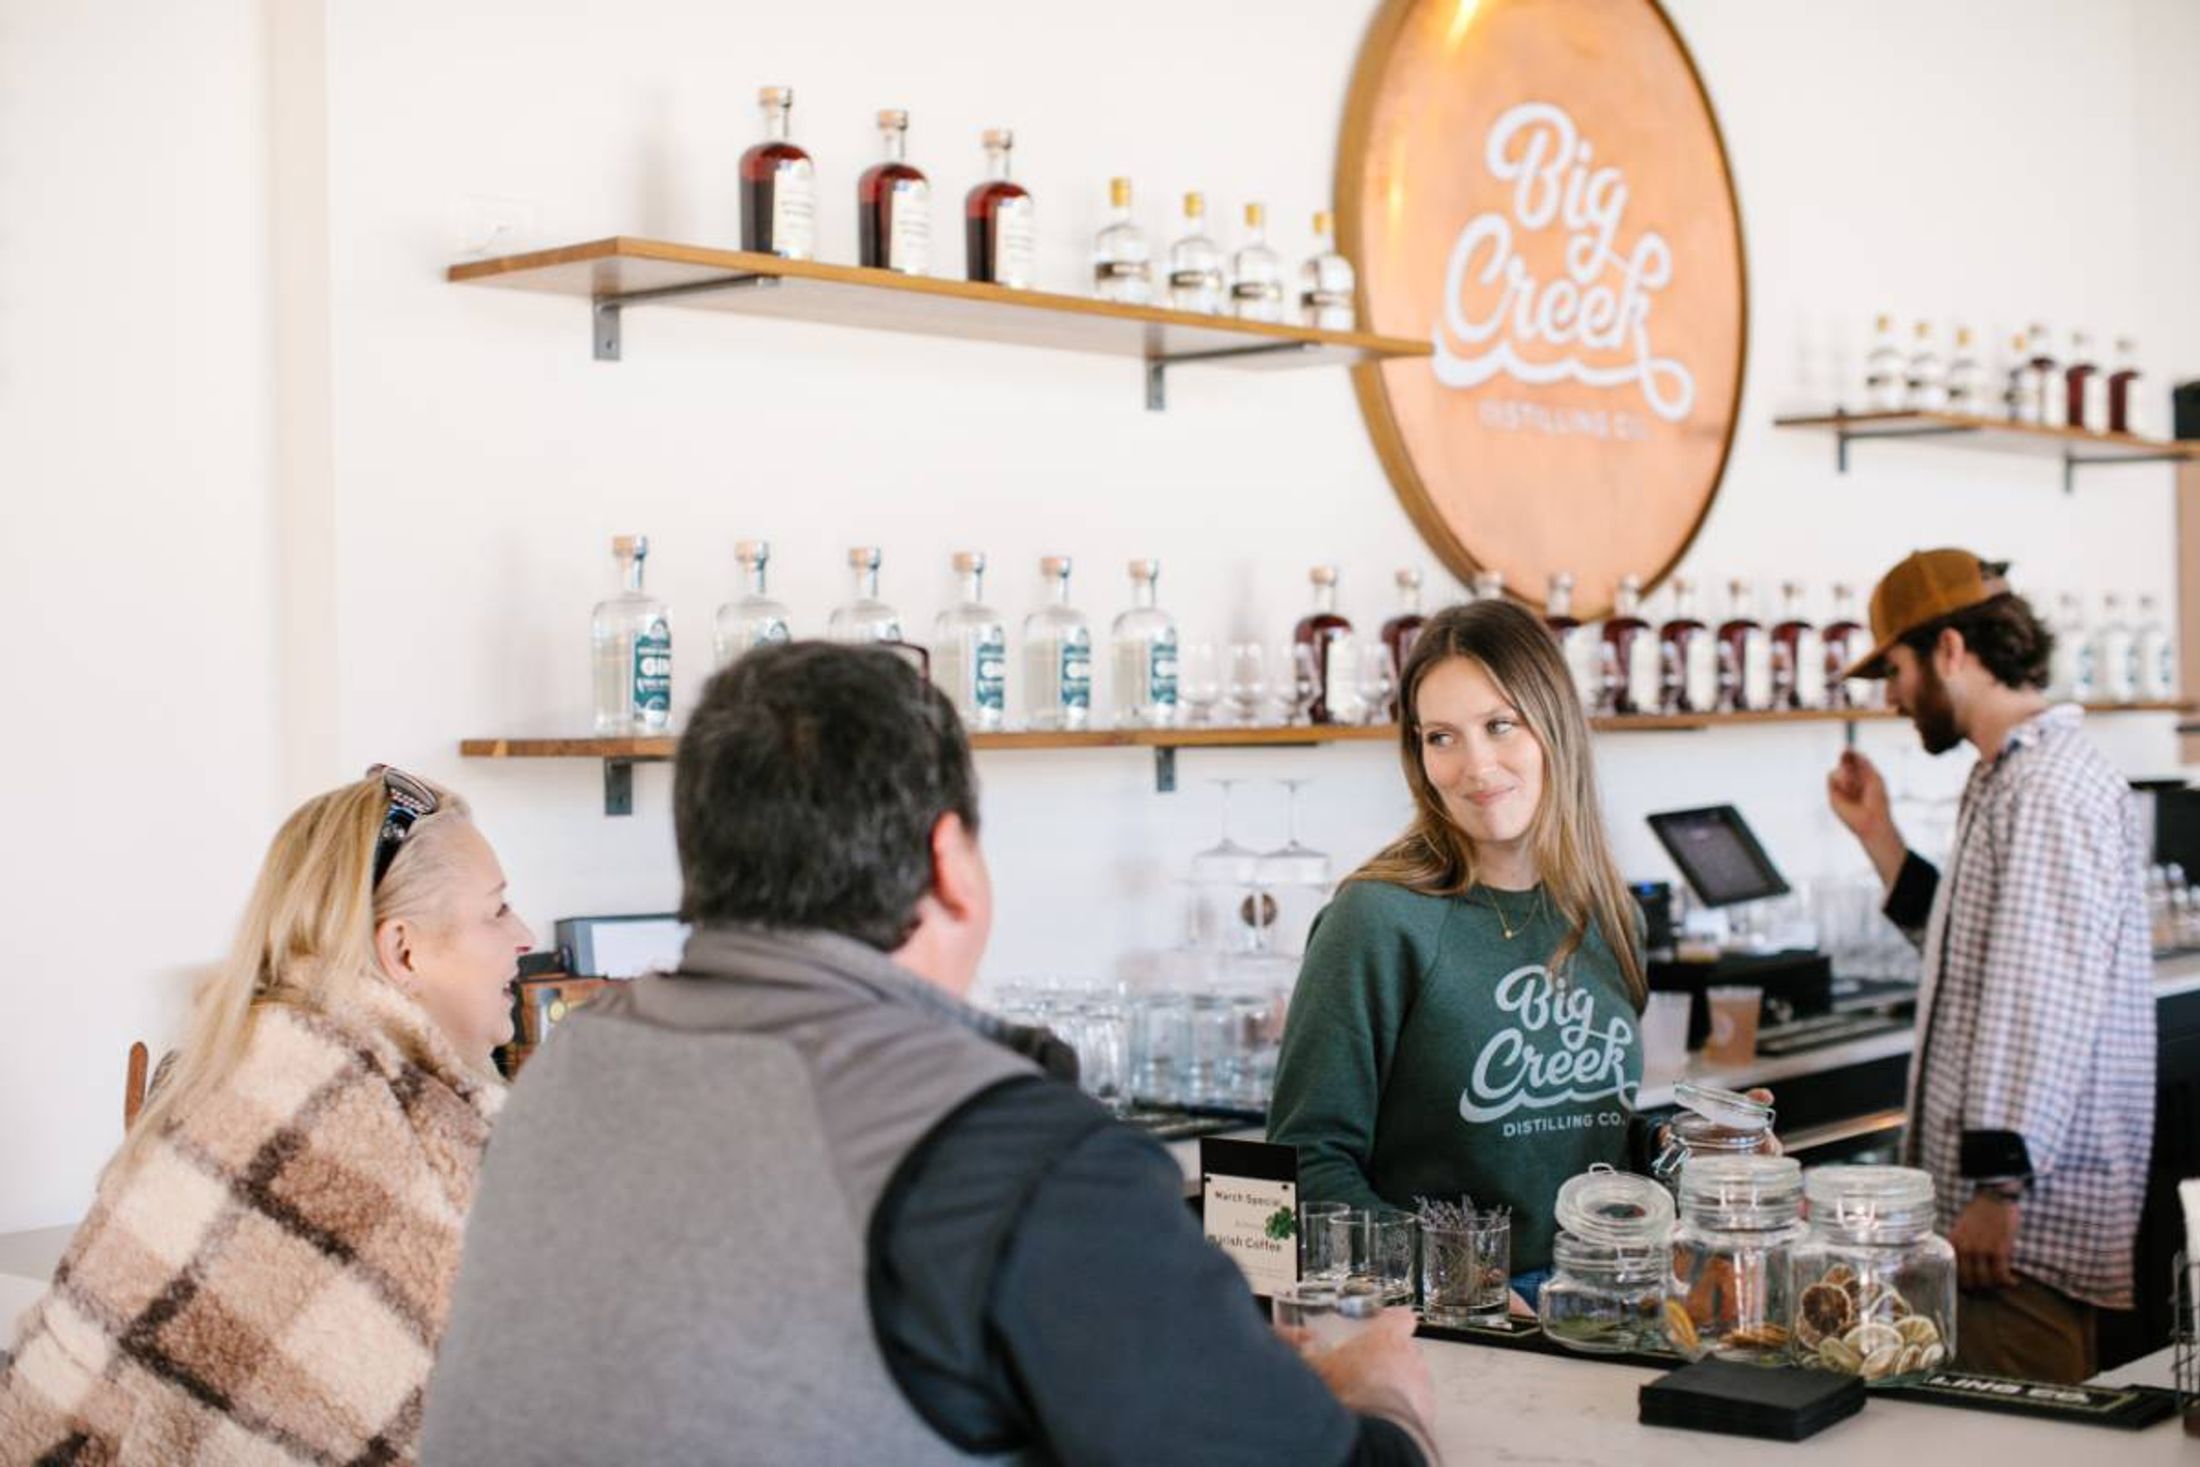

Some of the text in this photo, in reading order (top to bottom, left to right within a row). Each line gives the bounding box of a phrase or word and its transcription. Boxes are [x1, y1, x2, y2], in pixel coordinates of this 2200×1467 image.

[1485, 101, 1627, 283] Big
[1440, 213, 1683, 388] Creek
[1495, 964, 1594, 1050] Big
[1465, 1016, 1636, 1111] Creek
[1503, 1114, 1593, 1138] DISTILLING
[1214, 1190, 1243, 1202] March
[1245, 1237, 1281, 1252] Coffee
